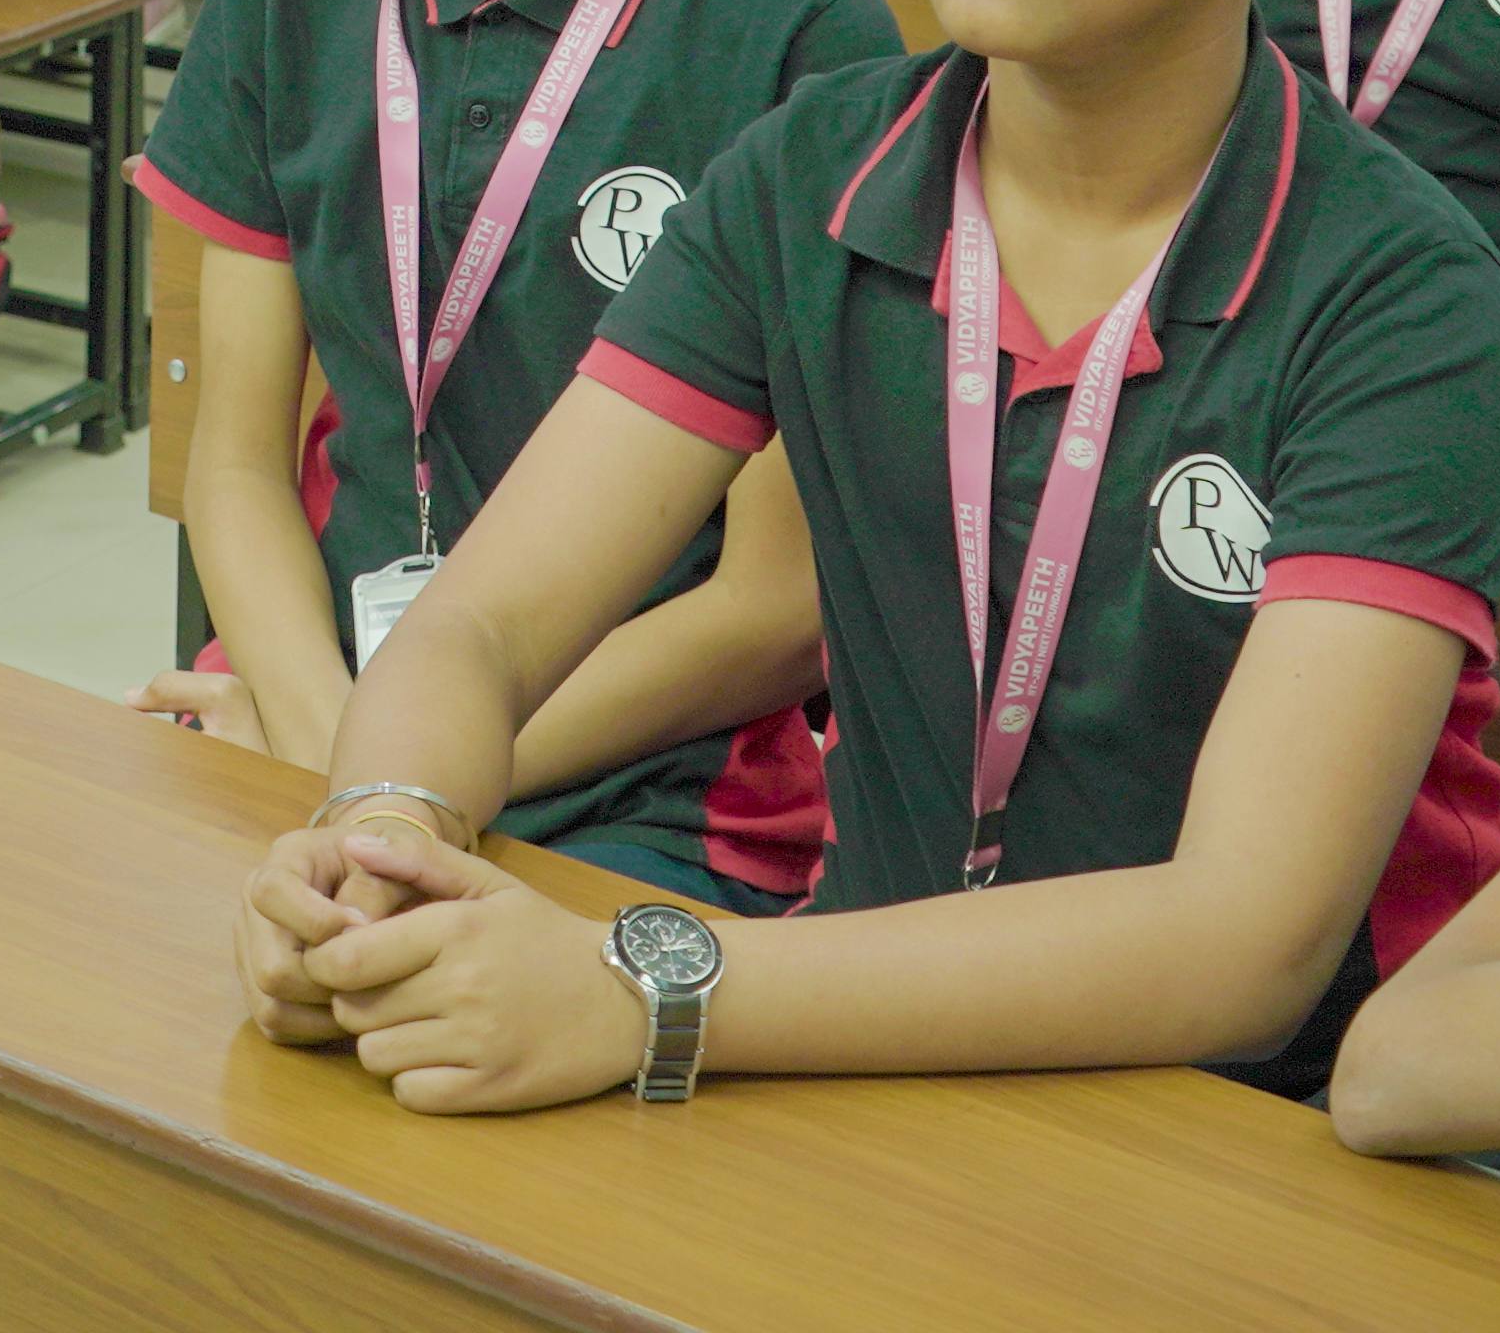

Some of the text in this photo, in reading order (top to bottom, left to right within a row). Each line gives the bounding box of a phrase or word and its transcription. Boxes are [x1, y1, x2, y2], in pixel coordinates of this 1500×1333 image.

[391, 205, 412, 330] VIDYAPEETH
[439, 216, 495, 330] VIDYAPEETH
[957, 215, 978, 364] VIDYAPEETH
[980, 294, 990, 318] NEET
[1072, 286, 1136, 426] VIDYAPEETH
[1104, 365, 1116, 390] NEET
[958, 503, 981, 649] VIDYAPEETH
[1181, 476, 1262, 591] PW
[1004, 556, 1055, 696] VIDYAPEETH
[1036, 634, 1051, 658] NEET
[1044, 562, 1069, 627] FOUNDATION
